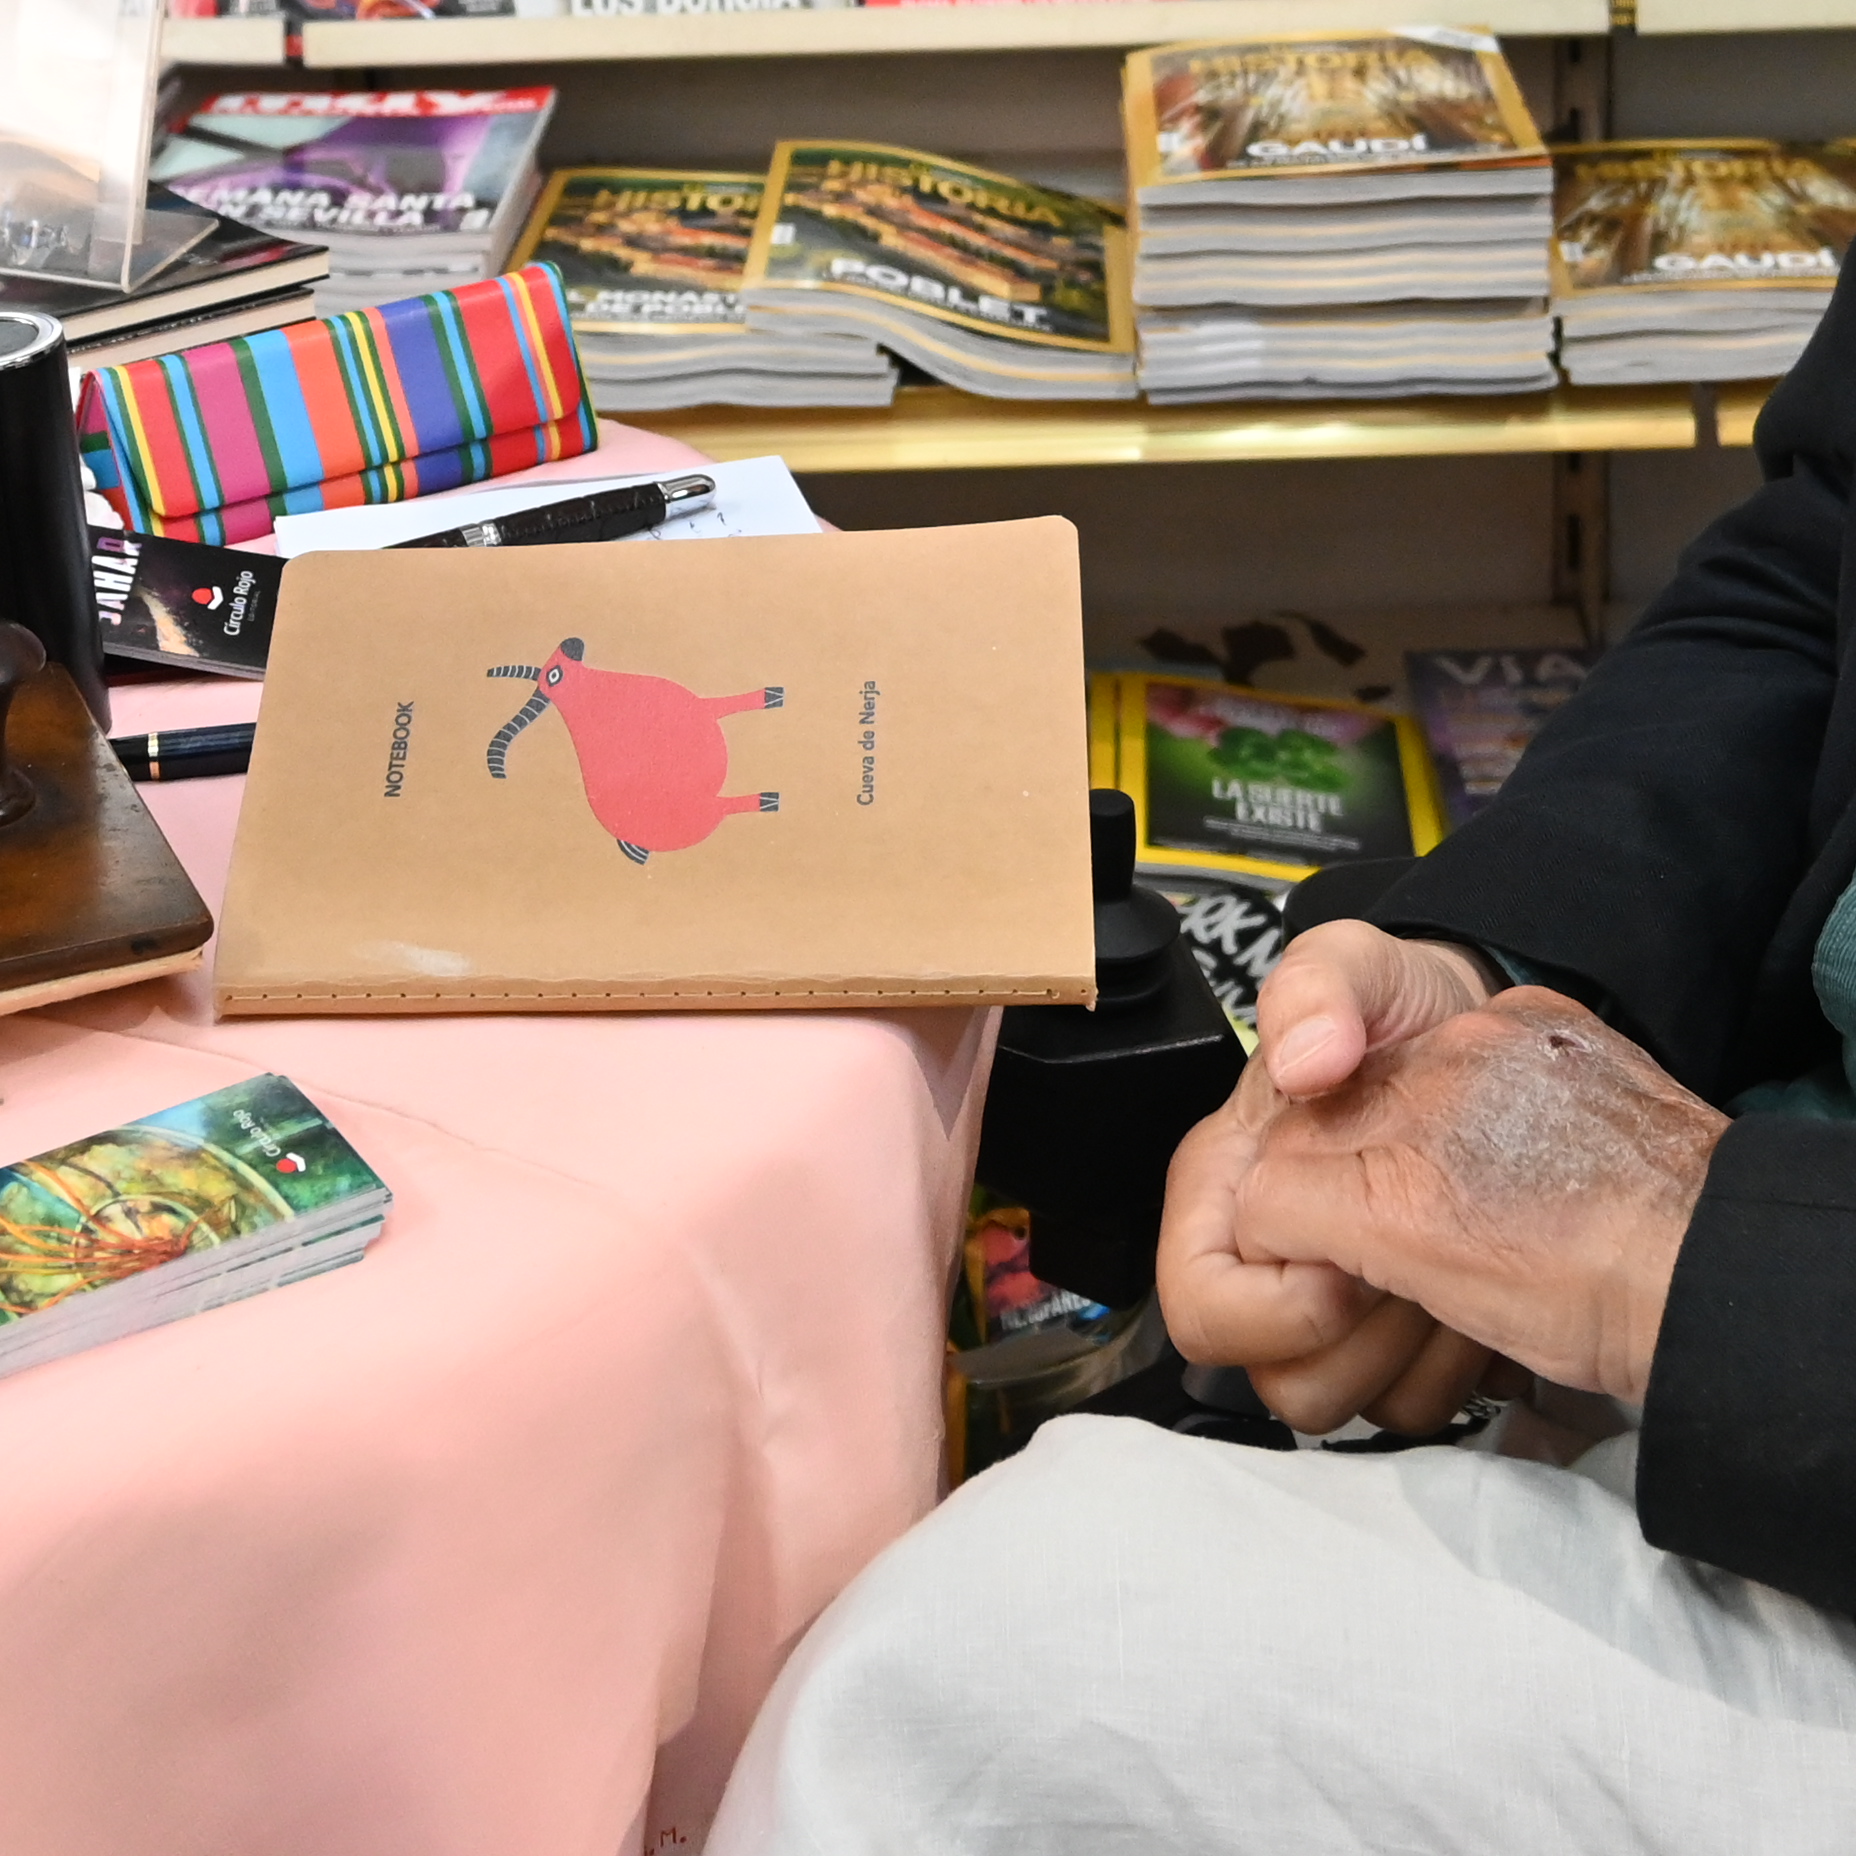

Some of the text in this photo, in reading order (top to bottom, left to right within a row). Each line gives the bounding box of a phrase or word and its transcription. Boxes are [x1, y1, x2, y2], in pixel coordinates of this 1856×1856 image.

[267, 203, 426, 229] SEVILLA
[830, 258, 1049, 329] POBLET
[224, 569, 254, 637] Círculo Rojo
[384, 701, 415, 800] NOTEBOOK
[857, 679, 880, 807] Cueva de Nerja
[1212, 779, 1343, 817] LA SUERTE
[1236, 802, 1323, 834] EXISTE
